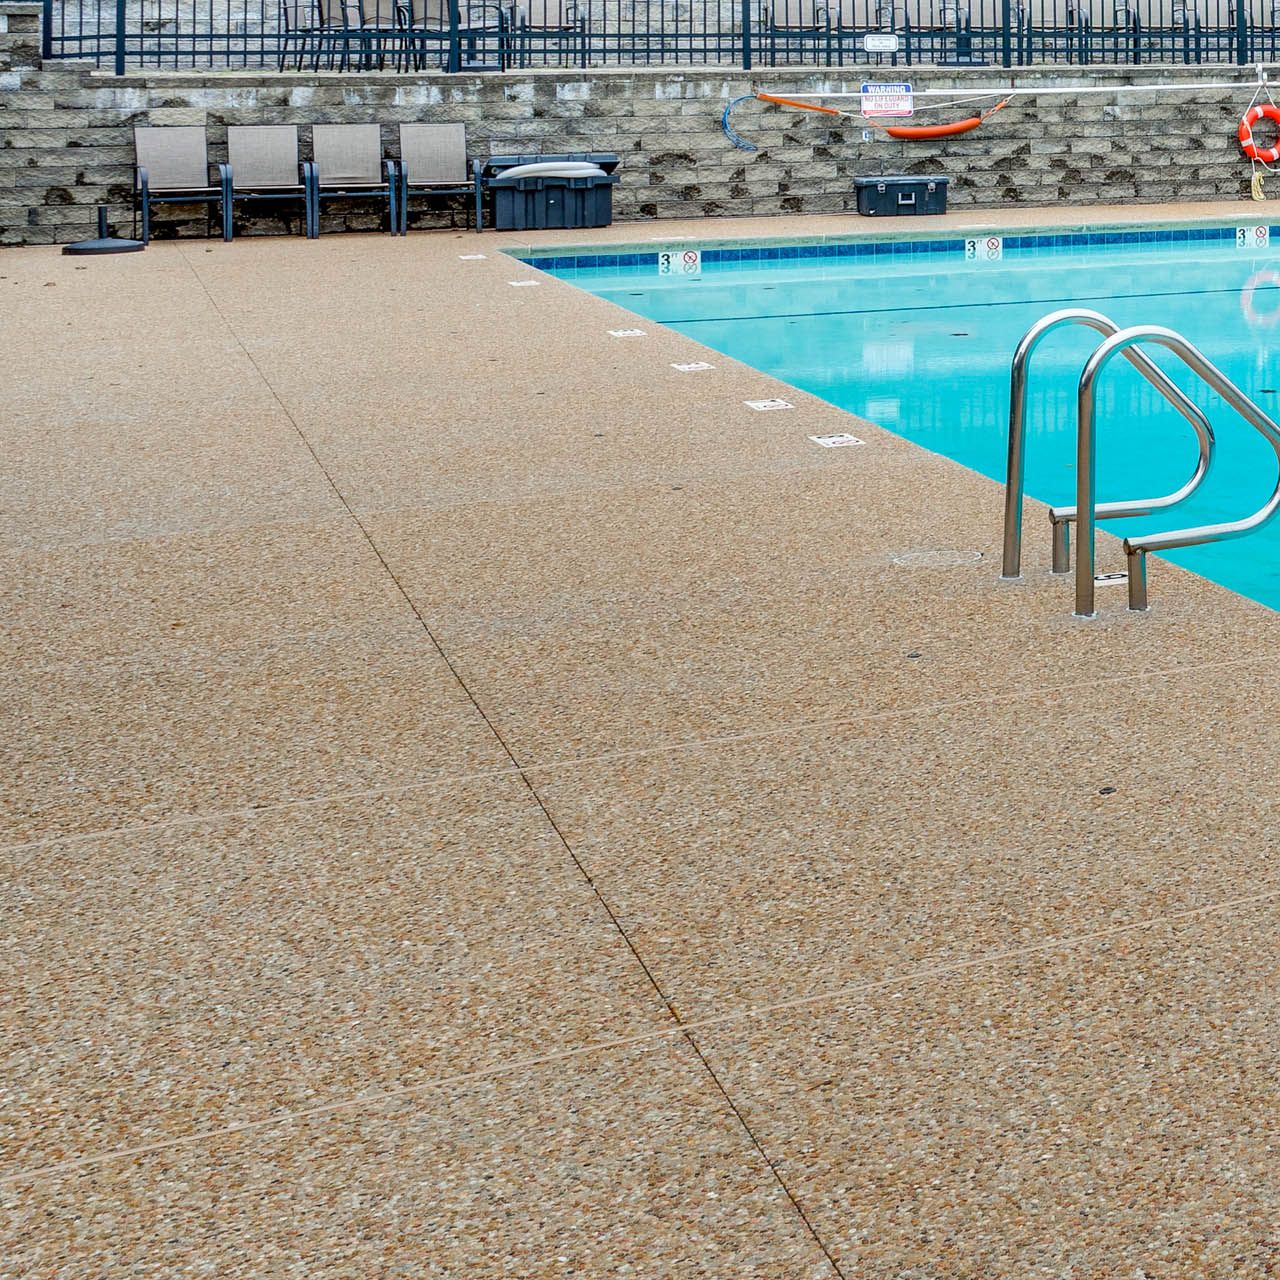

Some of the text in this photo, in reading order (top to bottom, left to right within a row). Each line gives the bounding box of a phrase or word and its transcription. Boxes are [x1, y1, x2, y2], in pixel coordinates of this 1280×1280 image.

[867, 85, 906, 94] WARNING
[1238, 228, 1246, 239] 3
[967, 240, 976, 252] 3
[661, 253, 671, 265] 3
